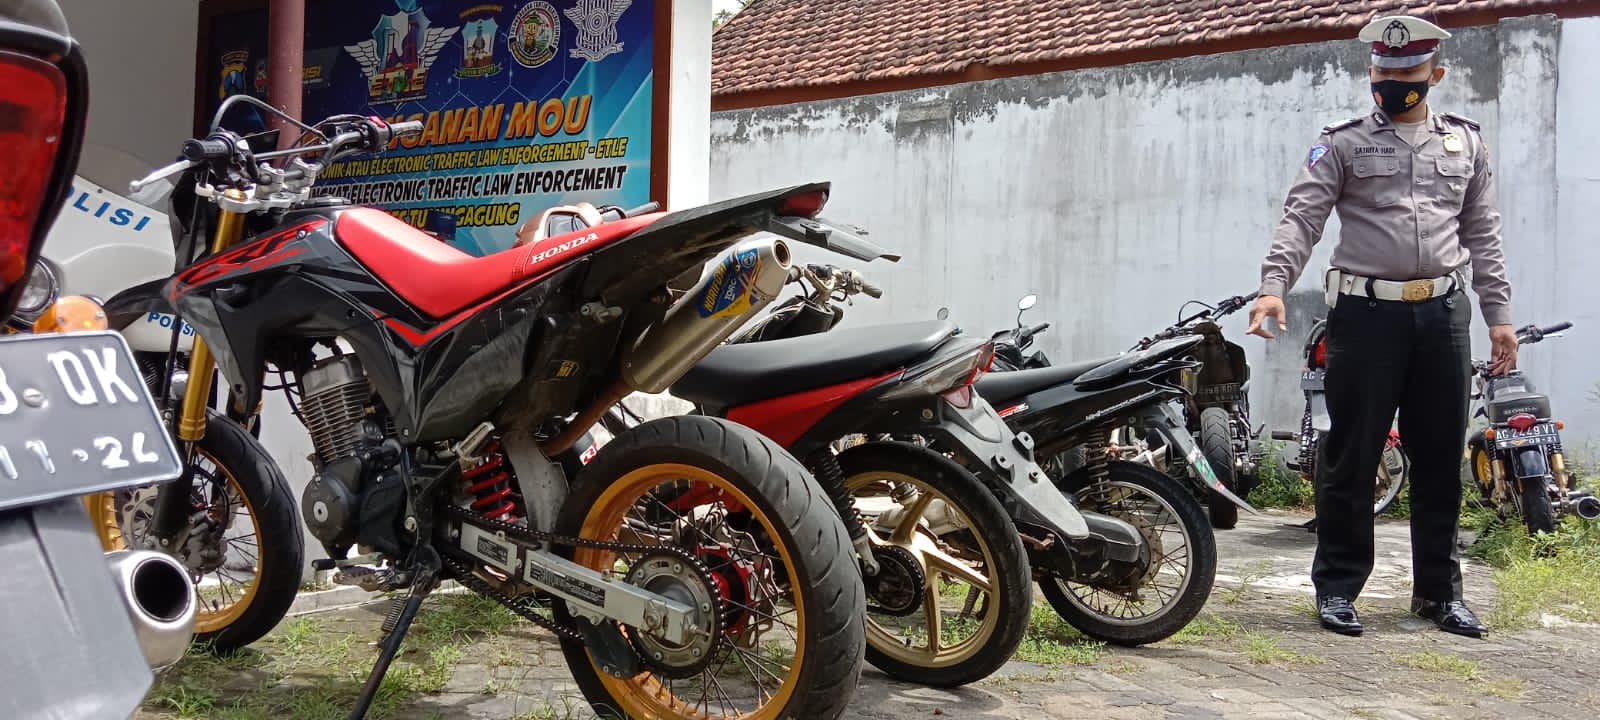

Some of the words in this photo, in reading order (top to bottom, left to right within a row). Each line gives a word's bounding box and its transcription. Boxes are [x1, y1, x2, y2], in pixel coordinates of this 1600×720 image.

[369, 66, 428, 97] ETLE
[505, 94, 592, 140] MOU
[345, 160, 370, 177] ATAU
[370, 155, 431, 176] ELECTRONIC
[432, 150, 477, 170] TRAFFIC
[476, 149, 501, 167] LAW
[501, 140, 589, 165] ENFORCEMENT
[595, 137, 628, 159] ETLE
[350, 178, 427, 205] ELECTRONIC
[427, 173, 484, 200] TRAFFIC
[483, 172, 515, 197] LAW
[514, 165, 628, 196] ENFORCEMENT
[531, 232, 599, 265] HONDA
[1542, 423, 1555, 434] VT
